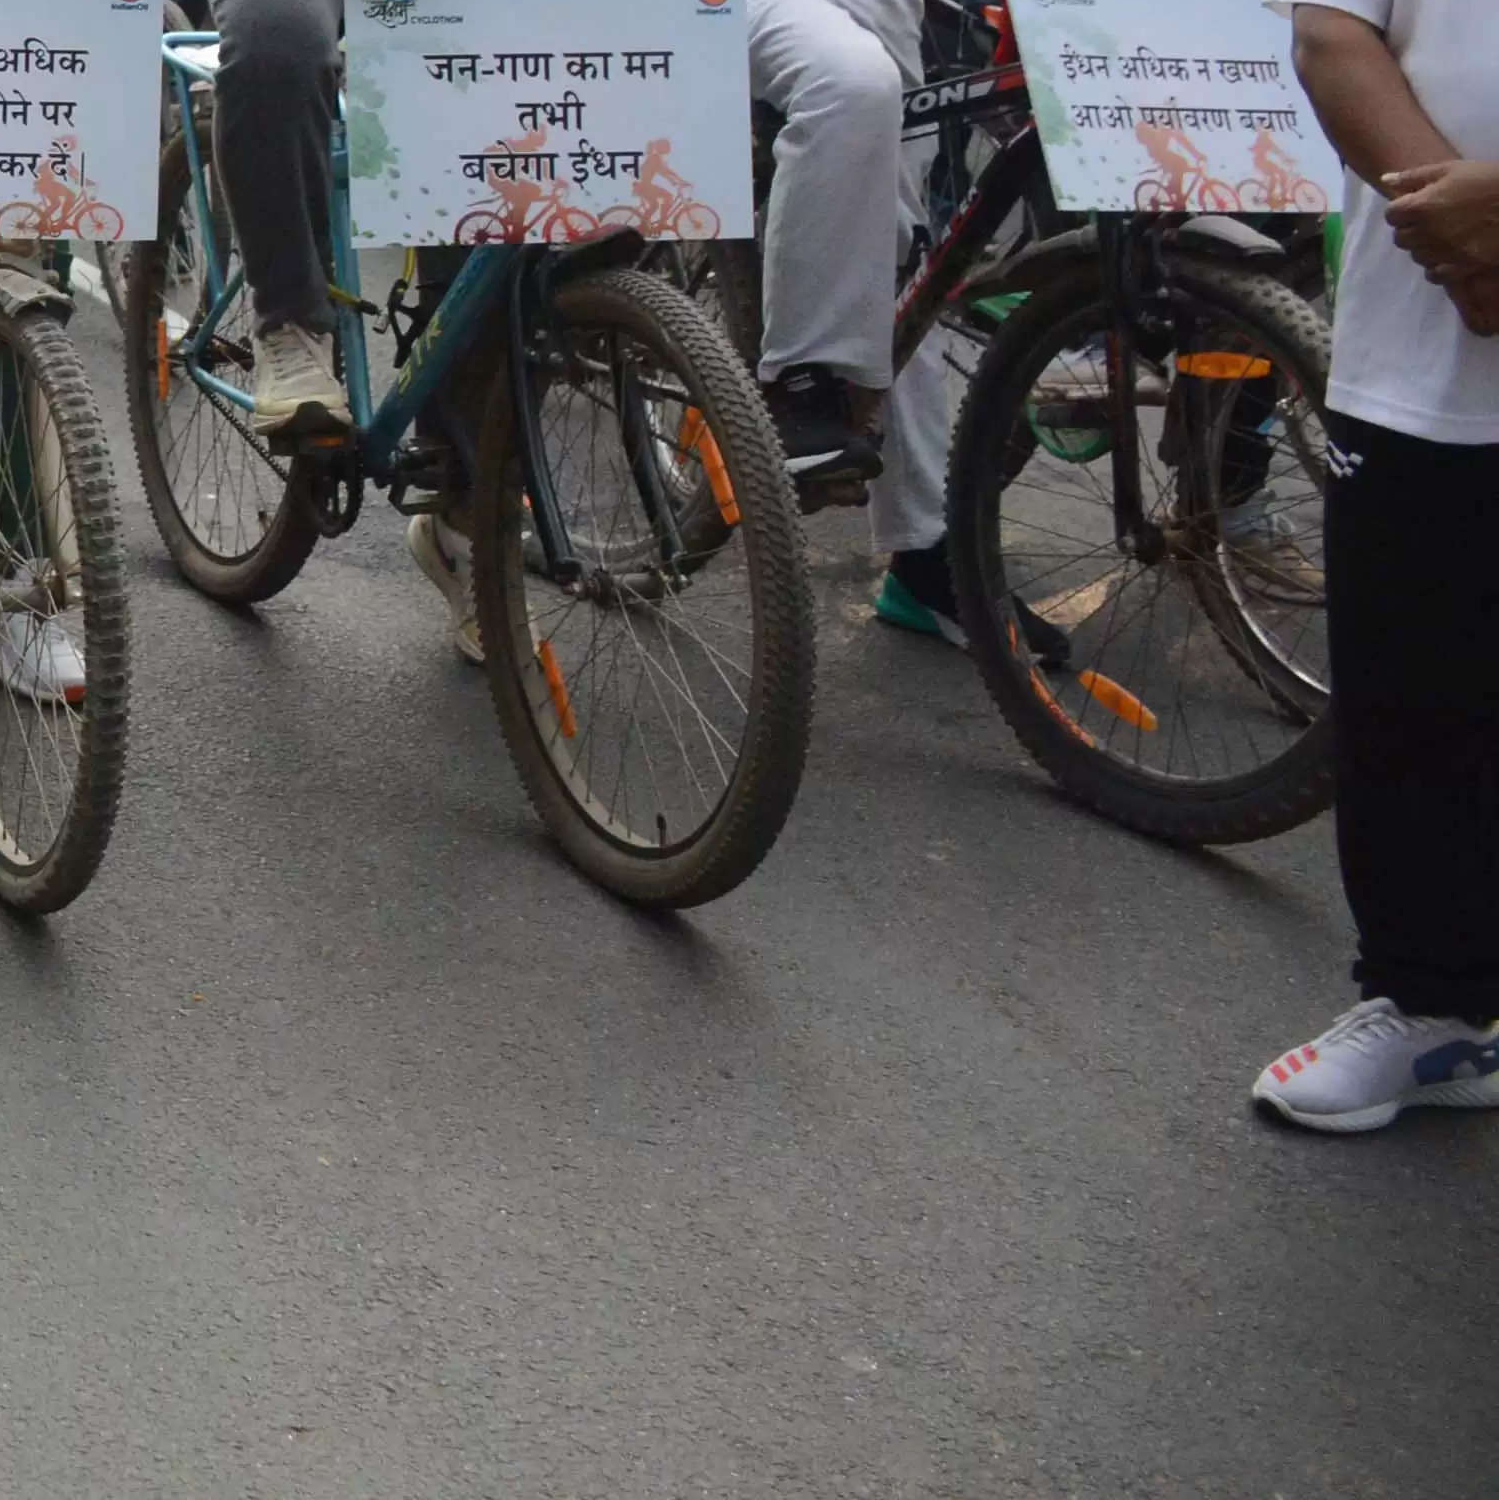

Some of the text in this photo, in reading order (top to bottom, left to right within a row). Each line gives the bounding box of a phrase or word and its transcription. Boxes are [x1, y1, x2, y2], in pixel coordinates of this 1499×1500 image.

[422, 51, 674, 82] जन-गण का मन
[1059, 43, 1108, 85] ईंधन
[1117, 45, 1189, 82] अधिक
[1192, 60, 1211, 82] न
[40, 101, 78, 127] पर
[515, 90, 586, 133] तभी
[904, 82, 966, 114] ON
[1071, 95, 1136, 131] आओ
[1139, 97, 1232, 132] पर्यावरण
[459, 139, 643, 192] बचेगा ईंधन
